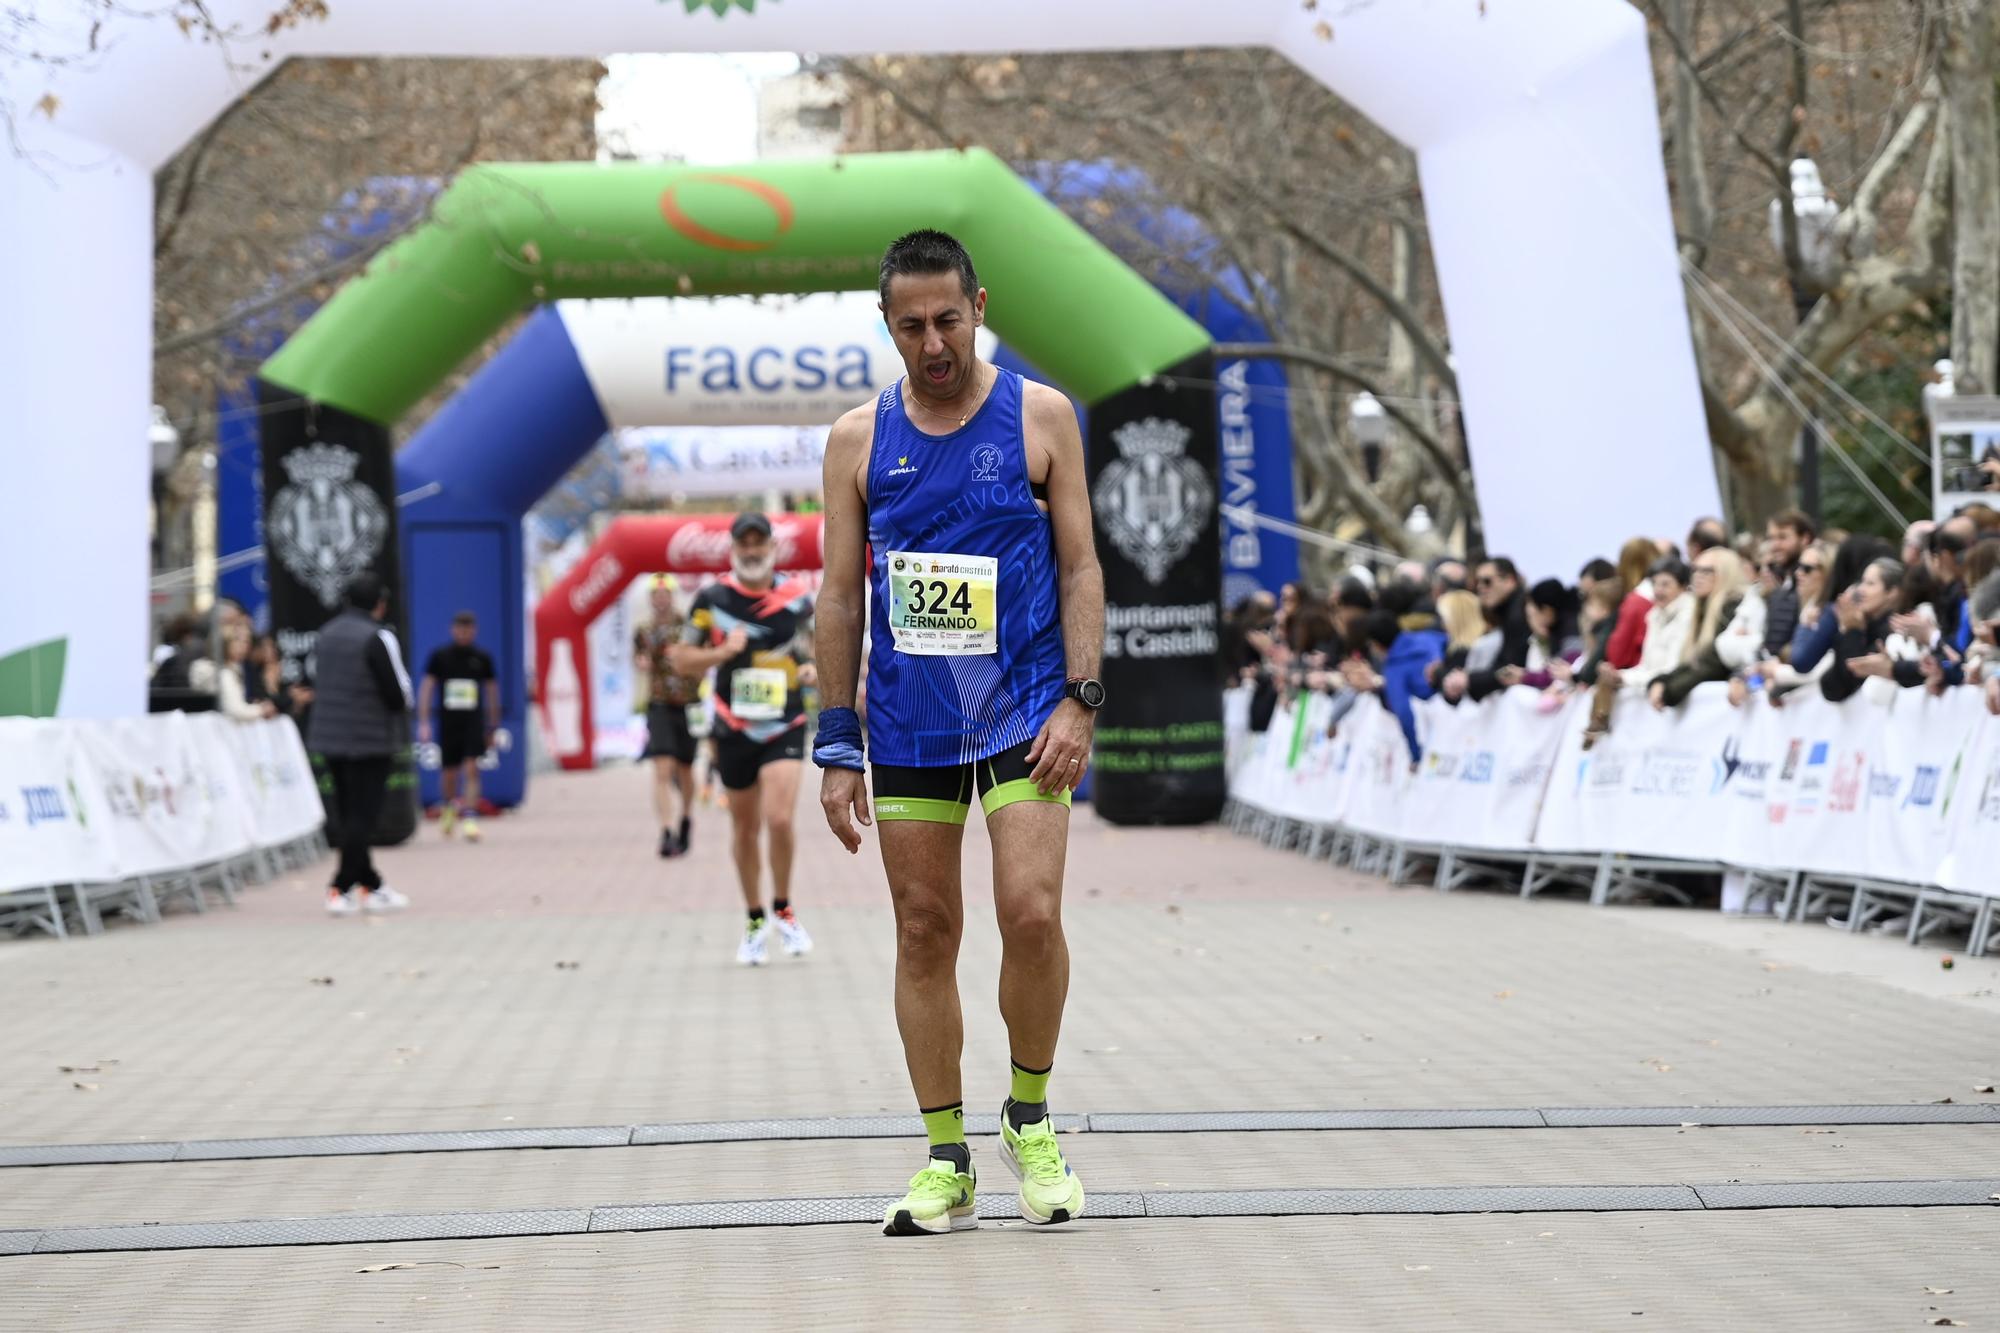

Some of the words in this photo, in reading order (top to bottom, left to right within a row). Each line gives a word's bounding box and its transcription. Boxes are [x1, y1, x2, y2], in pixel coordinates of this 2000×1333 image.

[1219, 360, 1261, 568] BAVIERA
[908, 579, 972, 615] 324
[903, 615, 977, 629] FERNANDO
